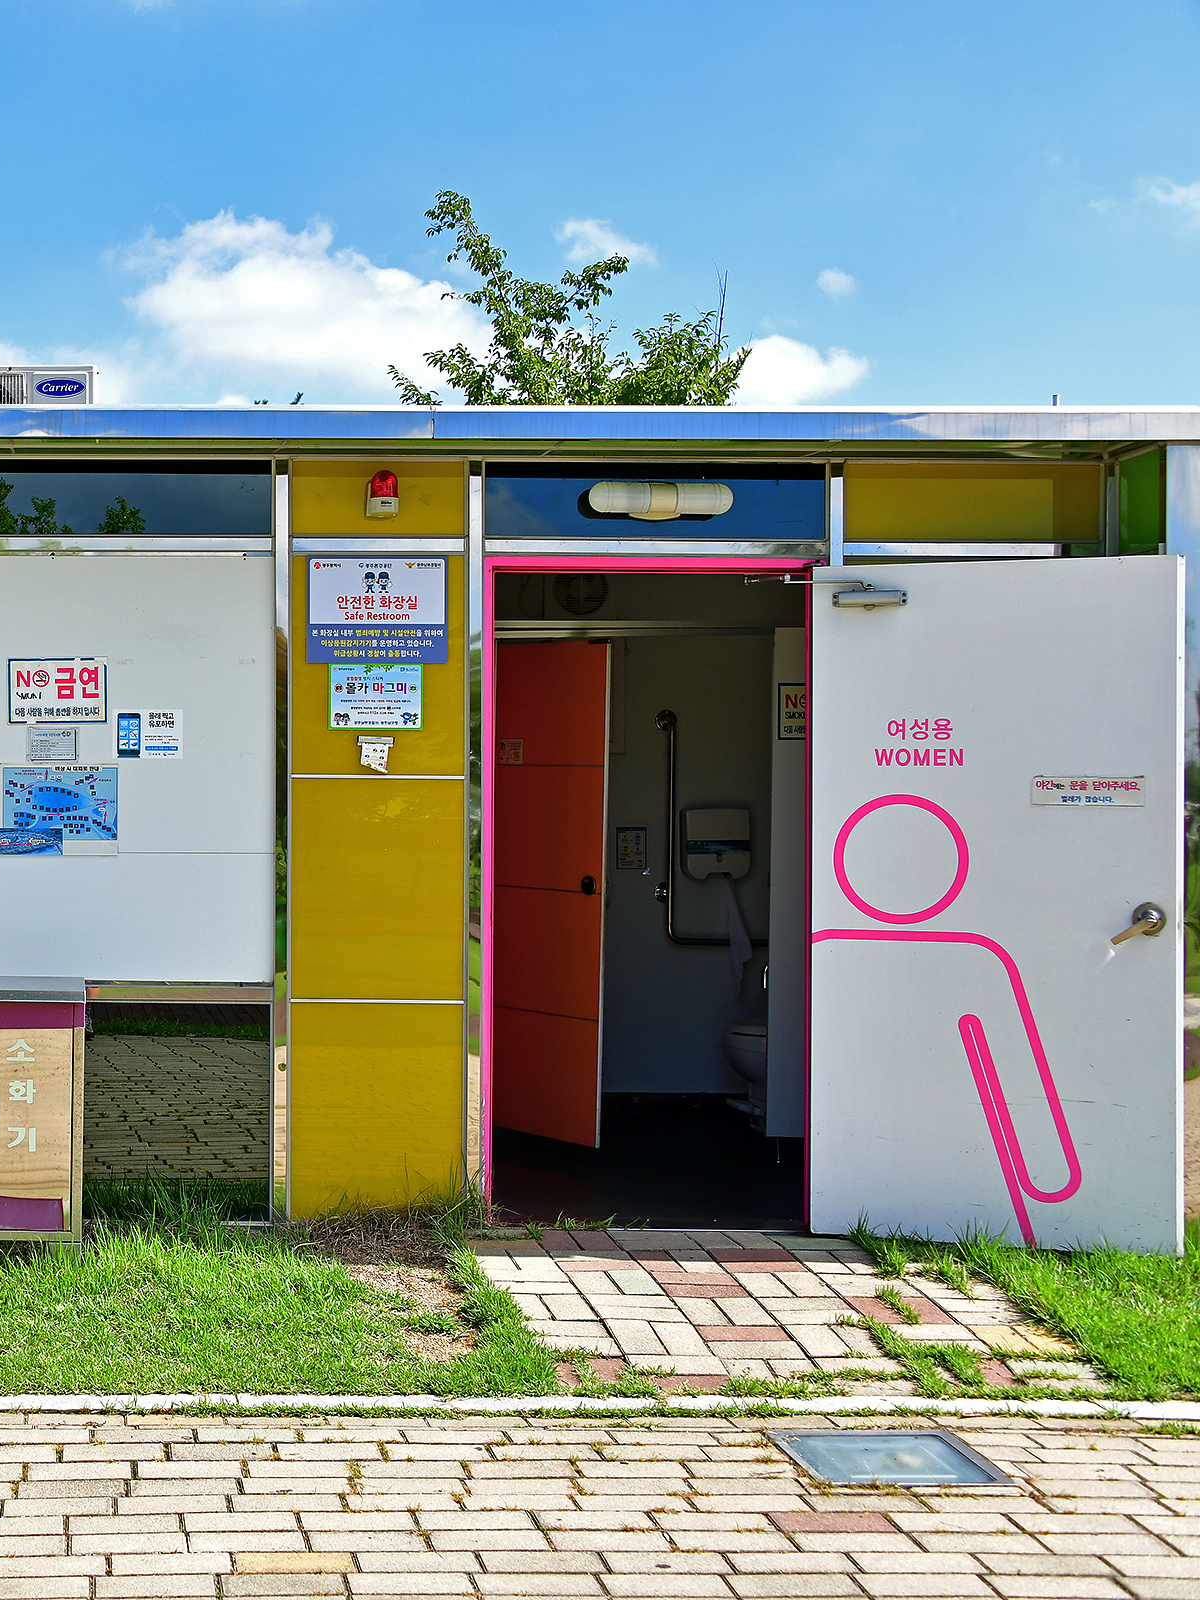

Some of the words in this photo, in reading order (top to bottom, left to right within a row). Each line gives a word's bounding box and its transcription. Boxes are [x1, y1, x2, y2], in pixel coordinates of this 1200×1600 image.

[42, 383, 79, 393] Carrier
[337, 595, 375, 610] 안전한
[379, 595, 418, 610] 화장실
[344, 611, 365, 621] Safe
[367, 611, 410, 621] Restroom
[320, 629, 339, 637] 화장실
[340, 629, 354, 637] 내부
[423, 629, 444, 637] 위하여
[379, 639, 405, 648] 운영하고
[54, 666, 100, 699] 금연
[345, 682, 369, 695] 몰카
[372, 682, 407, 695] 마그미
[14, 706, 26, 718] 다음
[886, 718, 954, 741] 여성용
[875, 747, 964, 767] WOMEN
[1069, 780, 1088, 791] 문을
